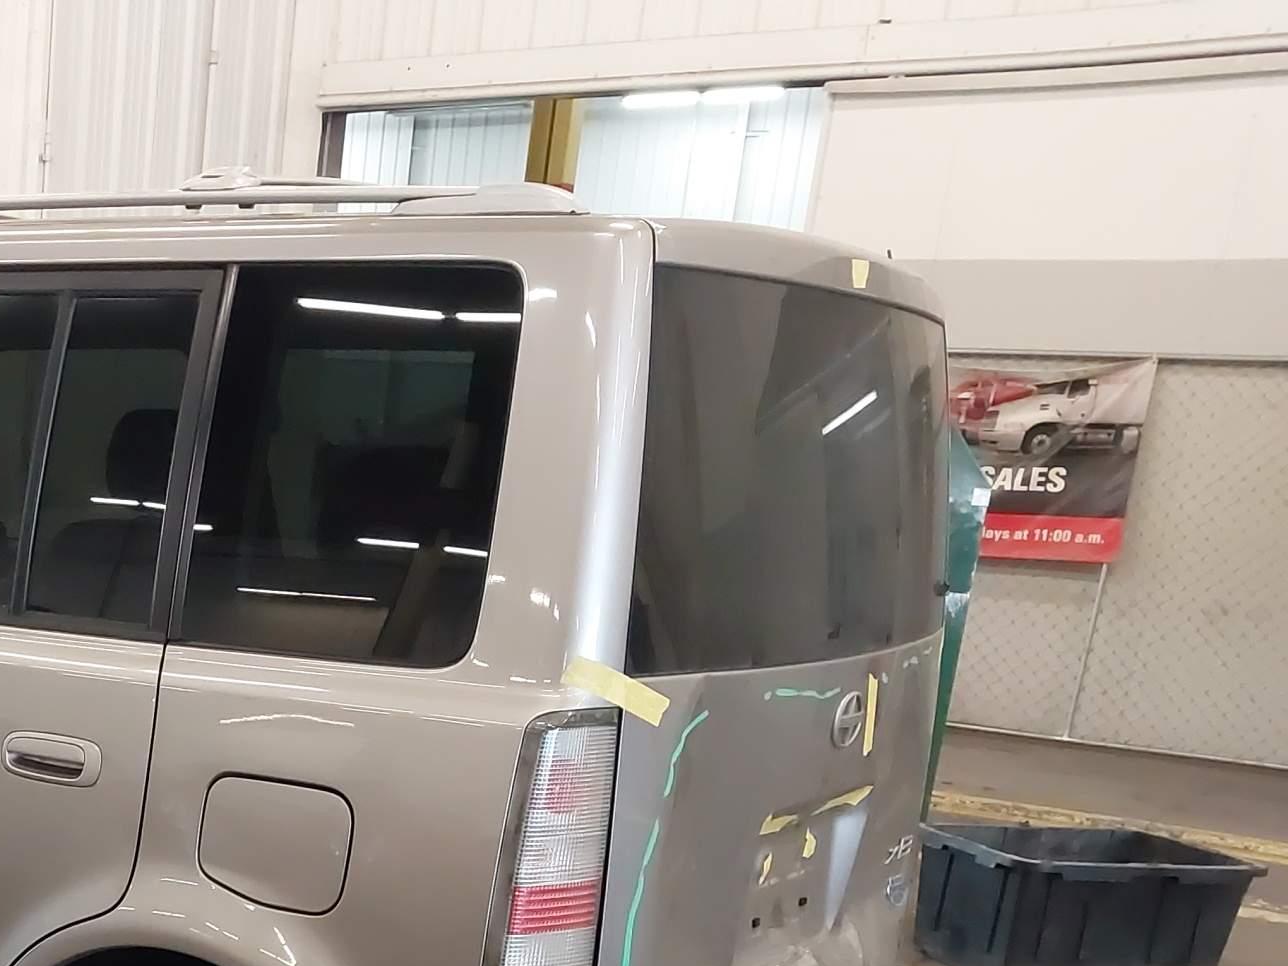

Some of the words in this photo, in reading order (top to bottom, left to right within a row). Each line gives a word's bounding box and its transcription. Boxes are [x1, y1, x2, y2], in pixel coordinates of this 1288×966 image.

[982, 526, 1010, 541] ays
[1013, 529, 1029, 540] at
[1034, 529, 1071, 542] 11:00
[1075, 533, 1105, 544] a.m.
